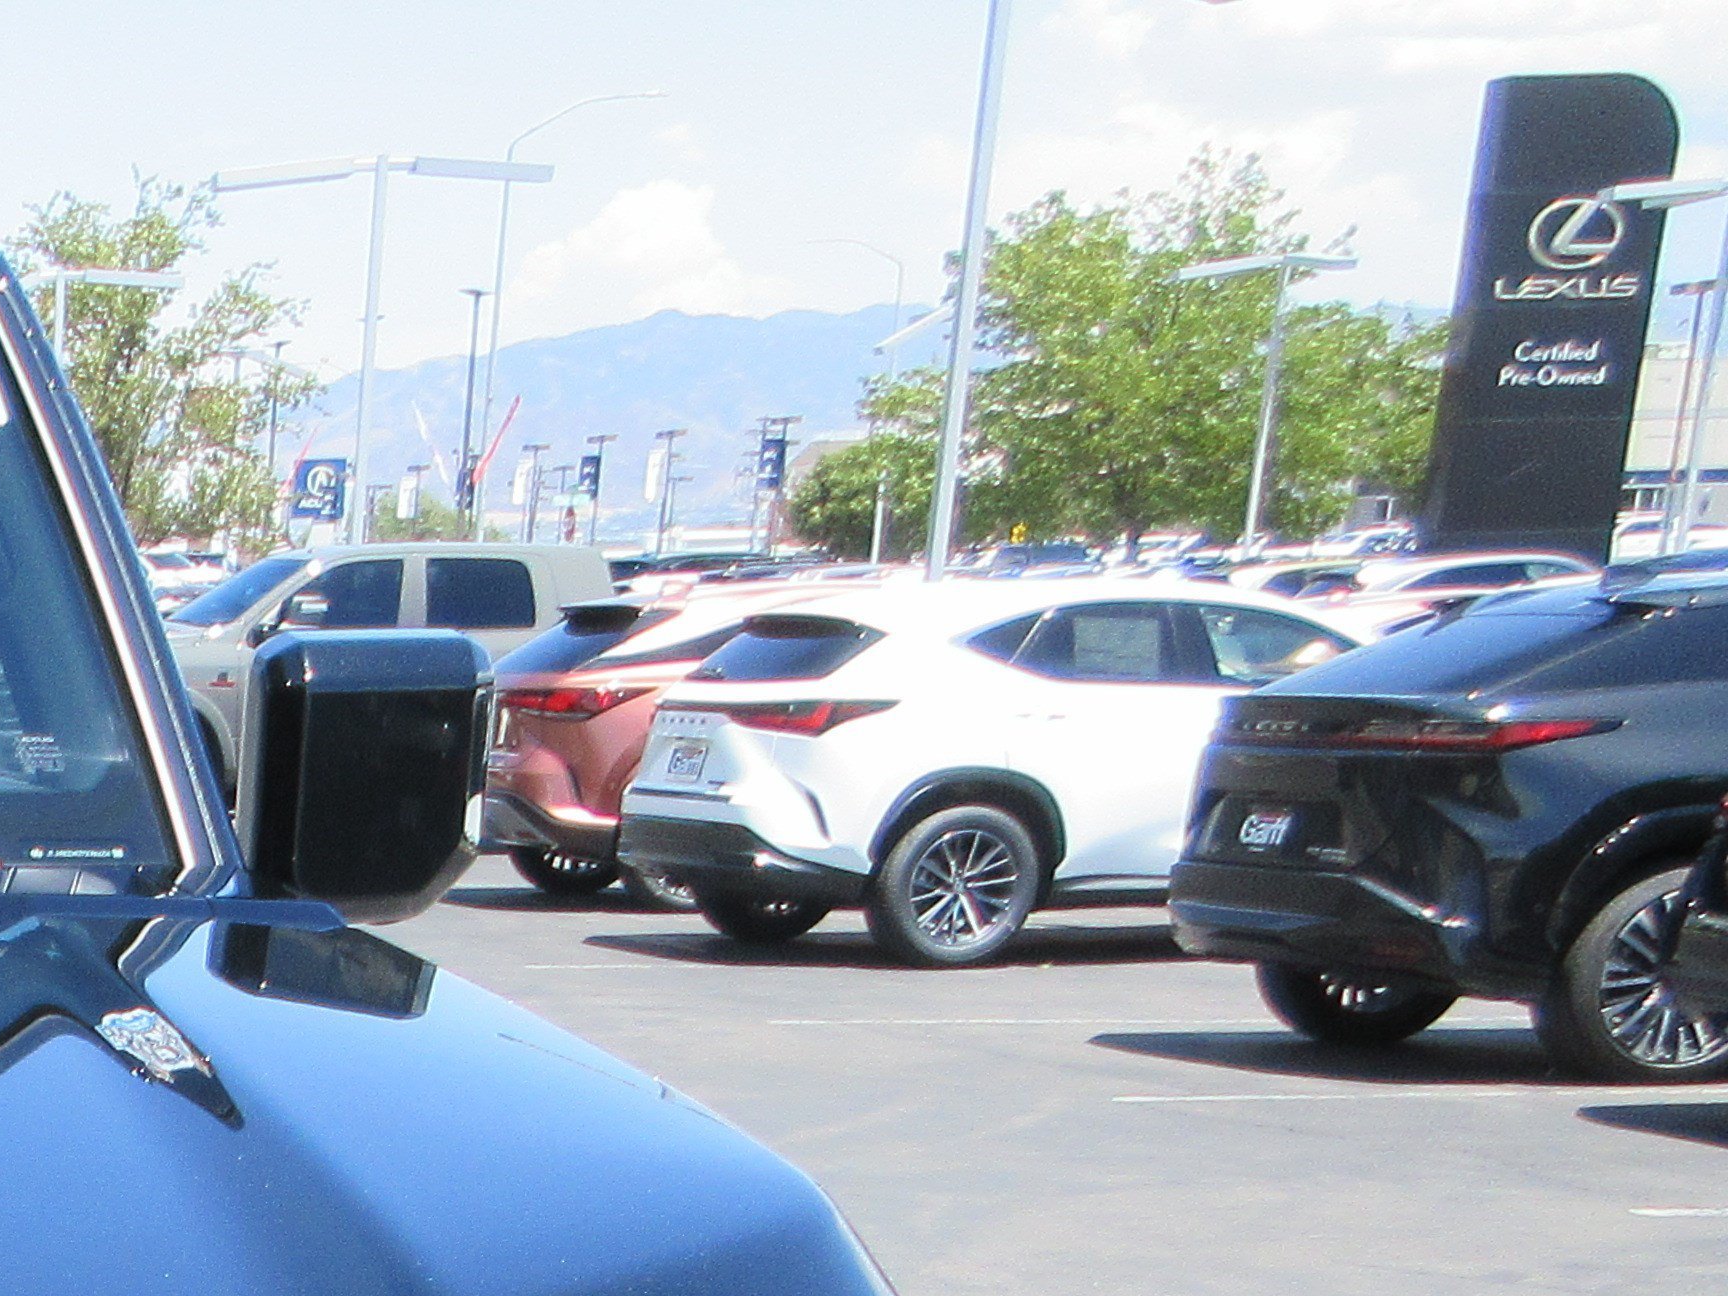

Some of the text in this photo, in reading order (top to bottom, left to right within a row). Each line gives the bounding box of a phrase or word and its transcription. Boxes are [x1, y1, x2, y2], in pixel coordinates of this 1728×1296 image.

[1493, 275, 1640, 300] LEXUS
[1514, 338, 1601, 363] Certified
[1496, 365, 1607, 388] Pre-Owned
